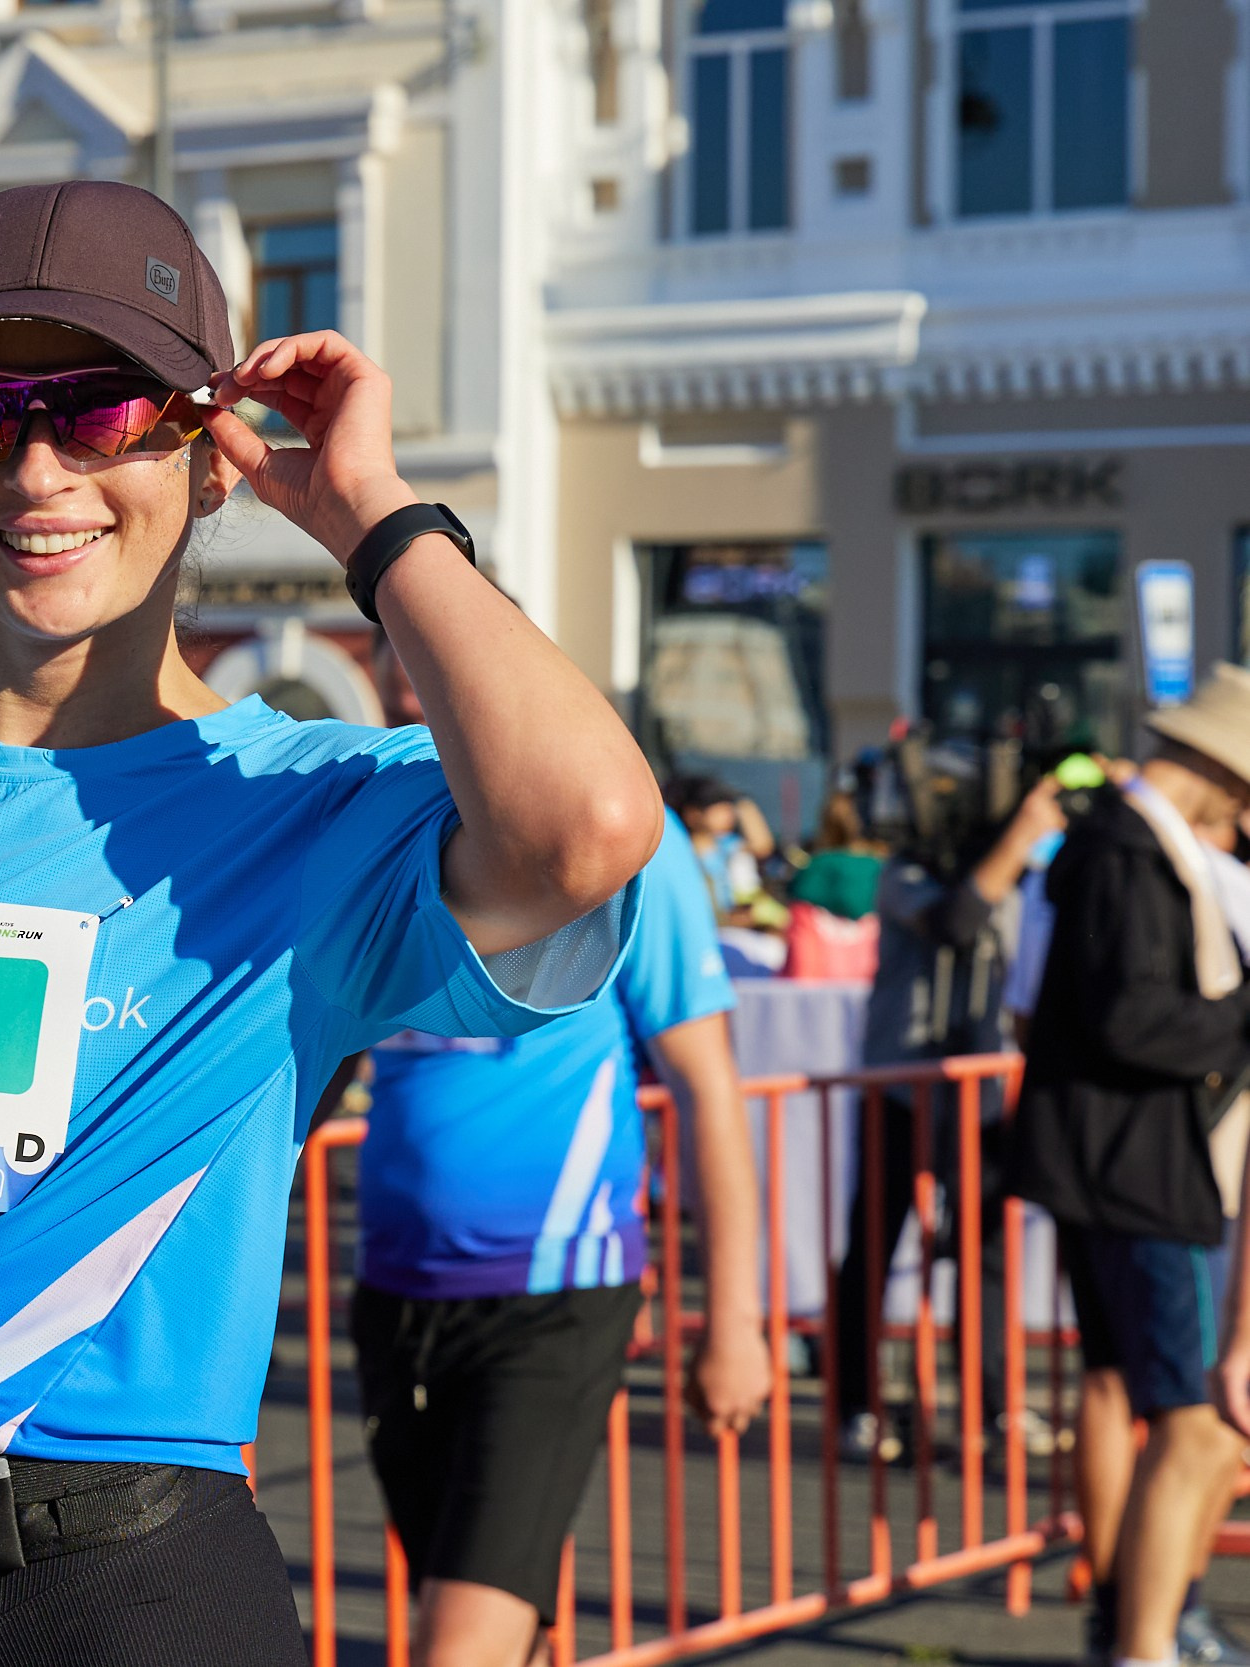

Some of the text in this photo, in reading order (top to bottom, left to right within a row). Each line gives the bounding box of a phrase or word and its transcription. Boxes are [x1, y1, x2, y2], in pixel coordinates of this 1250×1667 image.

[153, 268, 173, 291] Buff
[896, 457, 1124, 515] BORK
[14, 1132, 46, 1163] D
